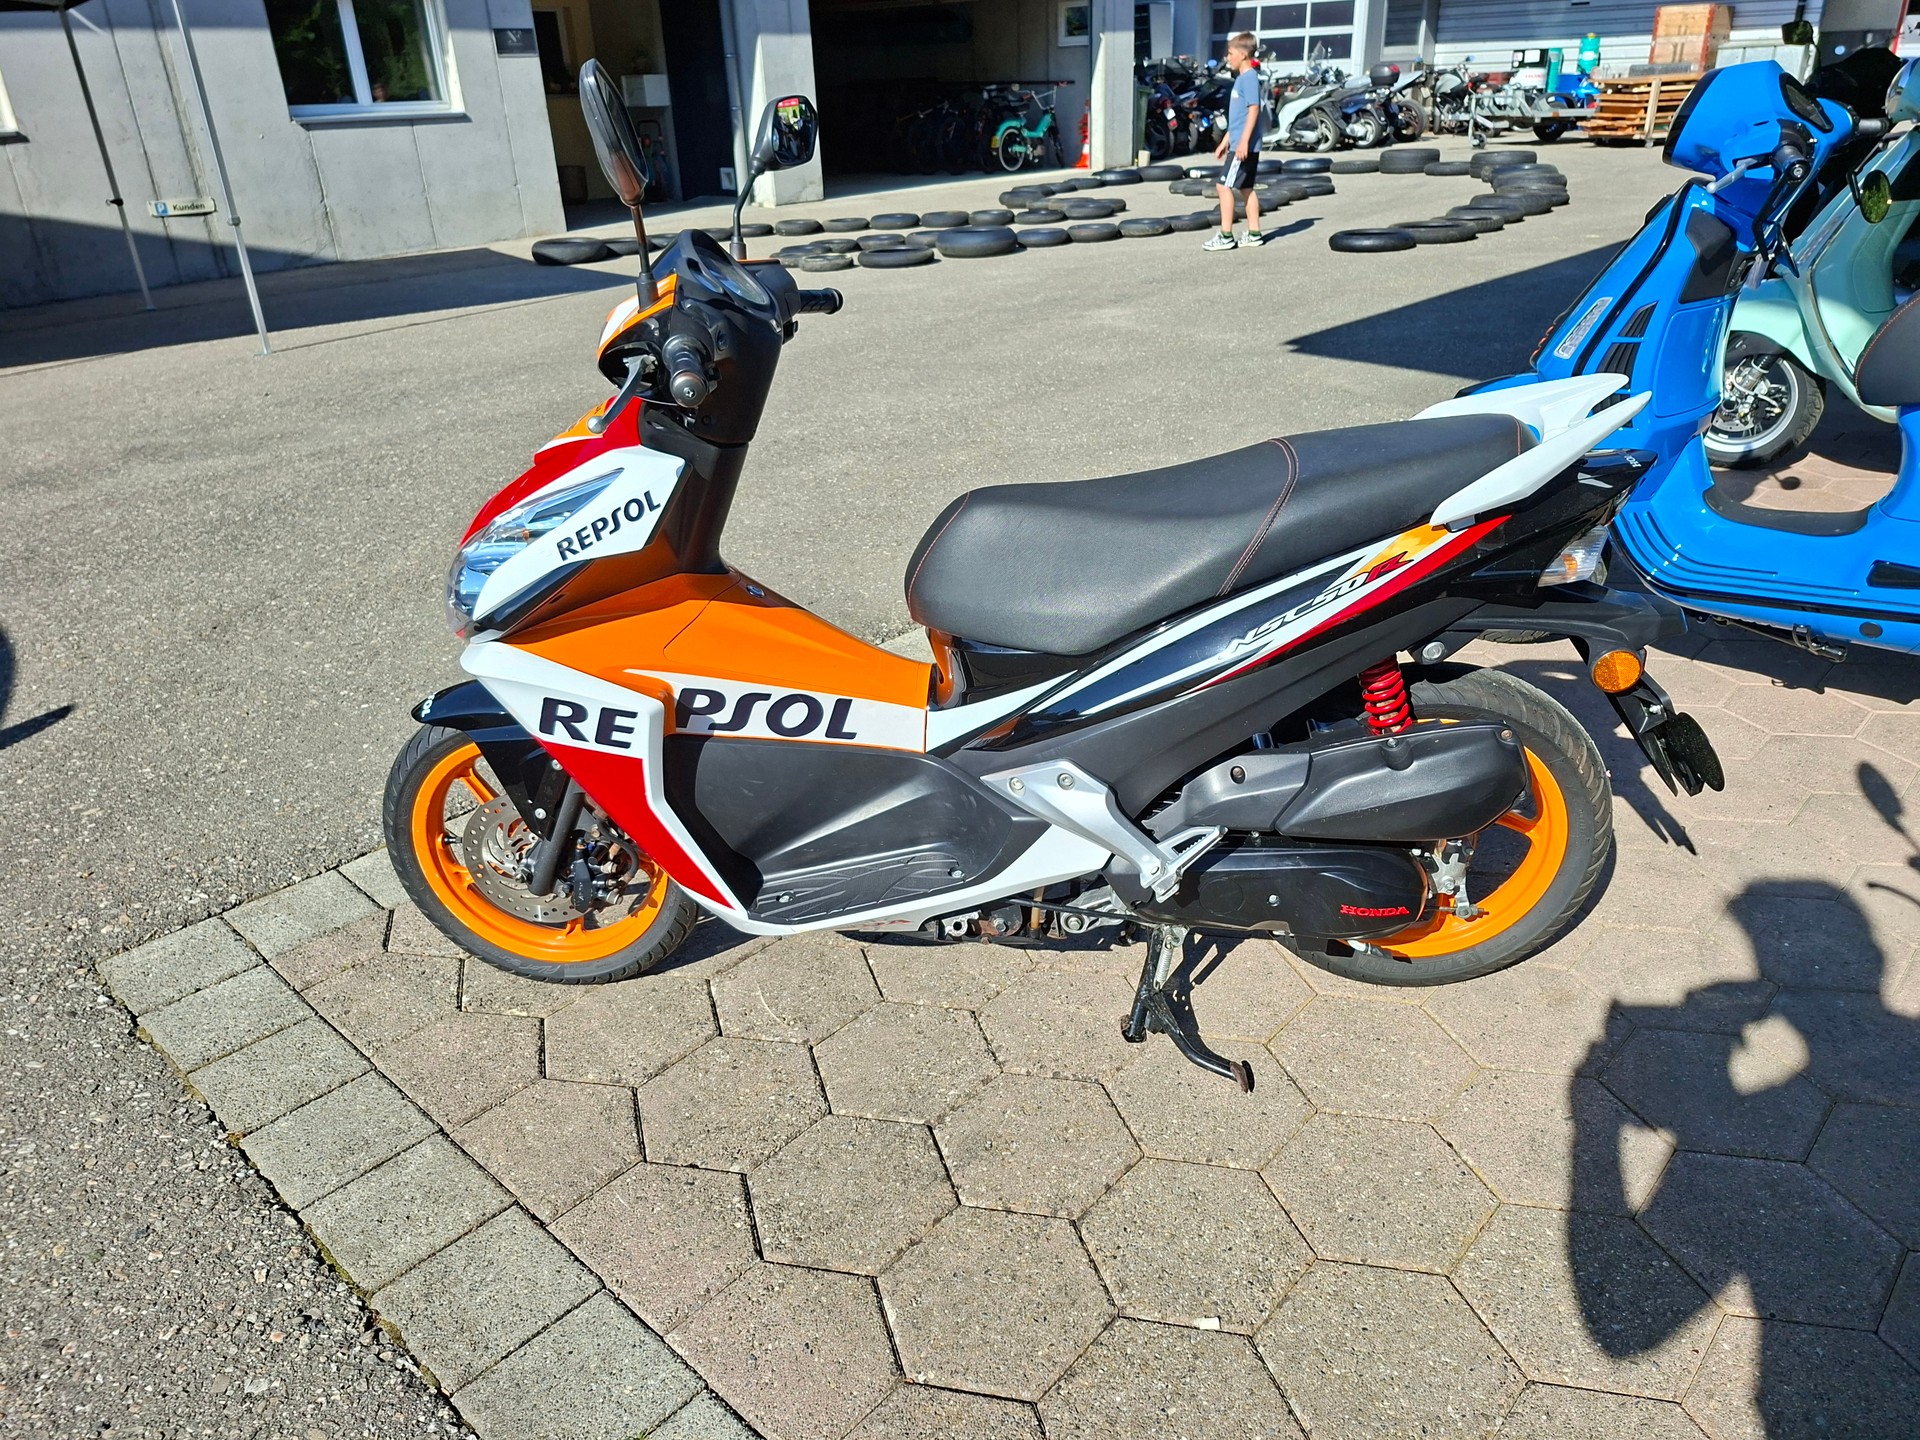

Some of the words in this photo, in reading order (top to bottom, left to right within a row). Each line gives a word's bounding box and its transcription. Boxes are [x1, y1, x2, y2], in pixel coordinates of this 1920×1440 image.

[172, 202, 206, 212] Kunden
[556, 490, 661, 562] REPSOL
[1340, 904, 1410, 917] HONDA
